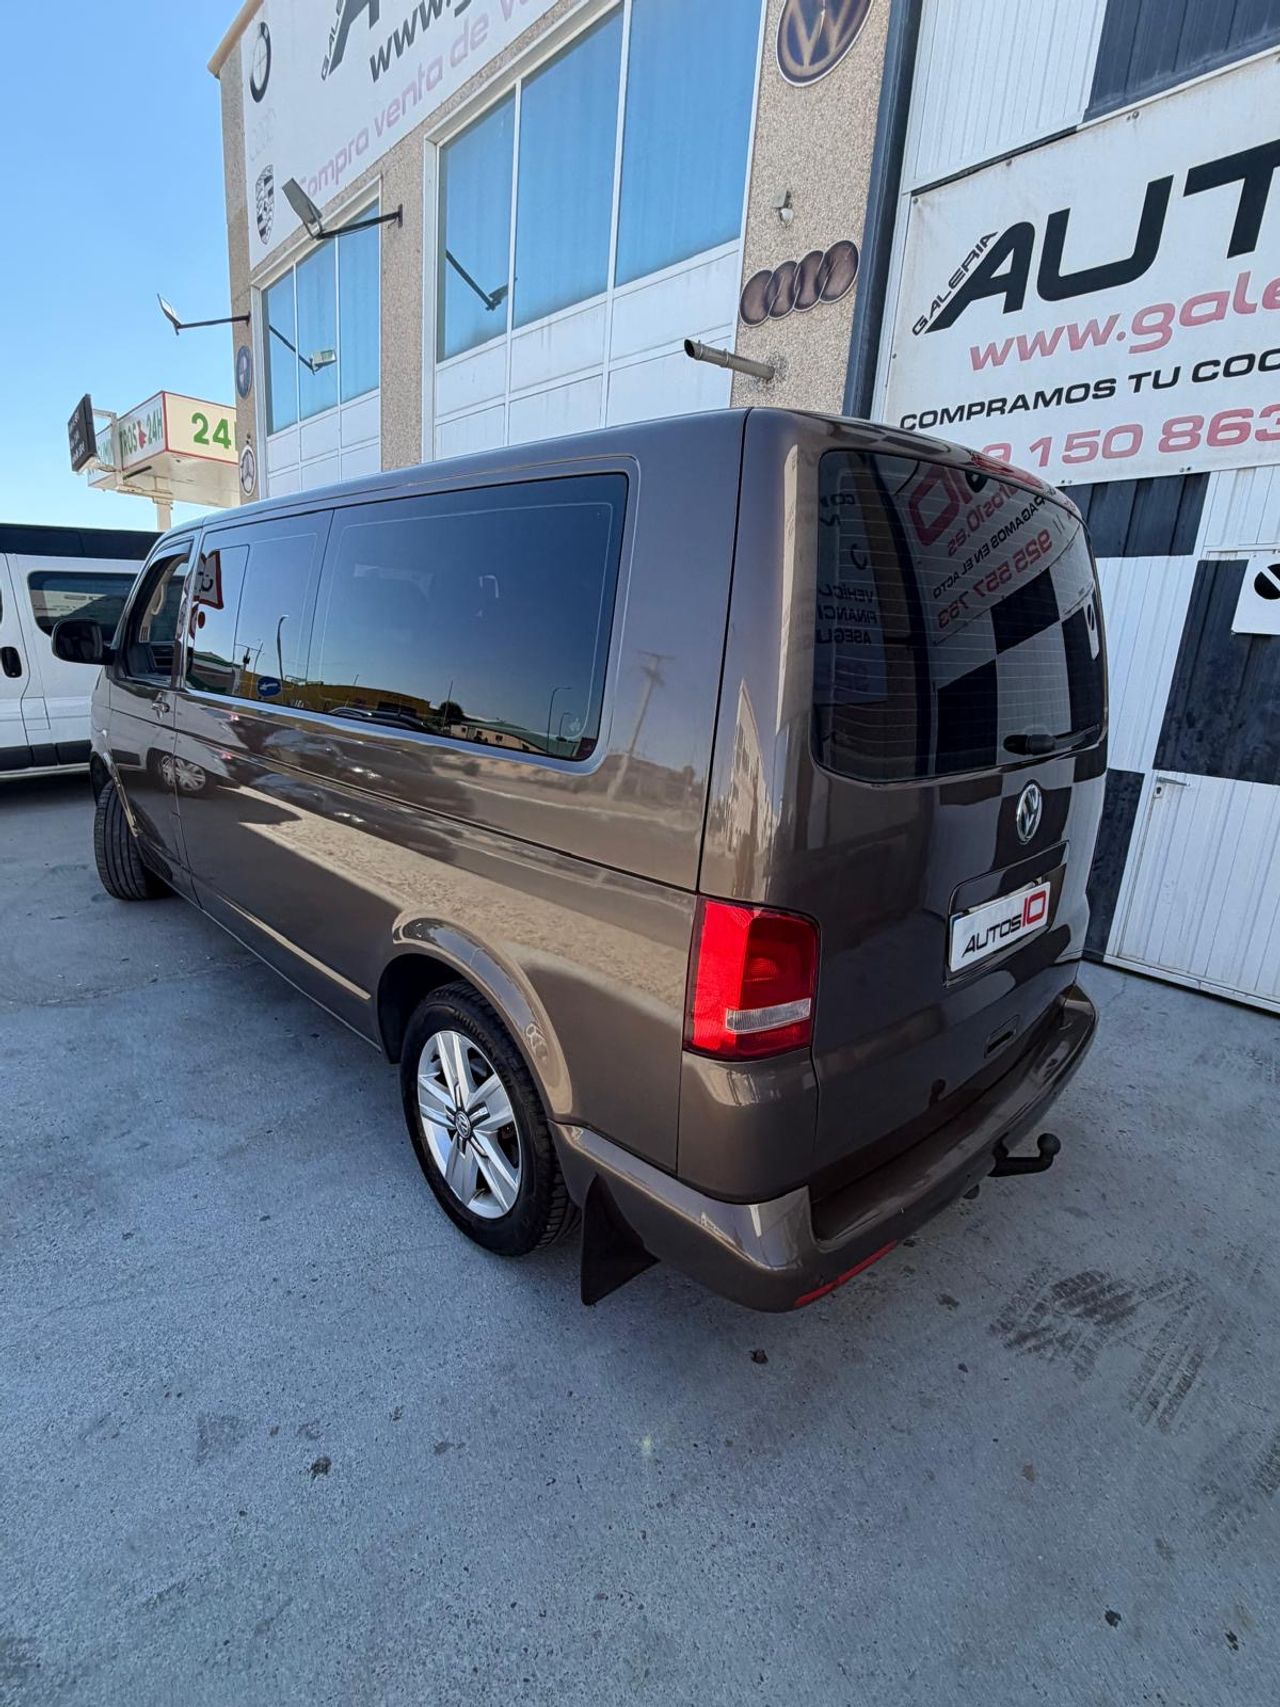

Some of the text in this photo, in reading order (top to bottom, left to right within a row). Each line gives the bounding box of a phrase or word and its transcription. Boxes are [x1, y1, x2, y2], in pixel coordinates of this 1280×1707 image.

[373, 55, 444, 138] venta
[450, 13, 490, 68] de
[912, 231, 998, 337] GALERIA
[900, 377, 1116, 431] COMPRAMOS
[1128, 366, 1181, 394] TU
[1029, 423, 1144, 467] 150
